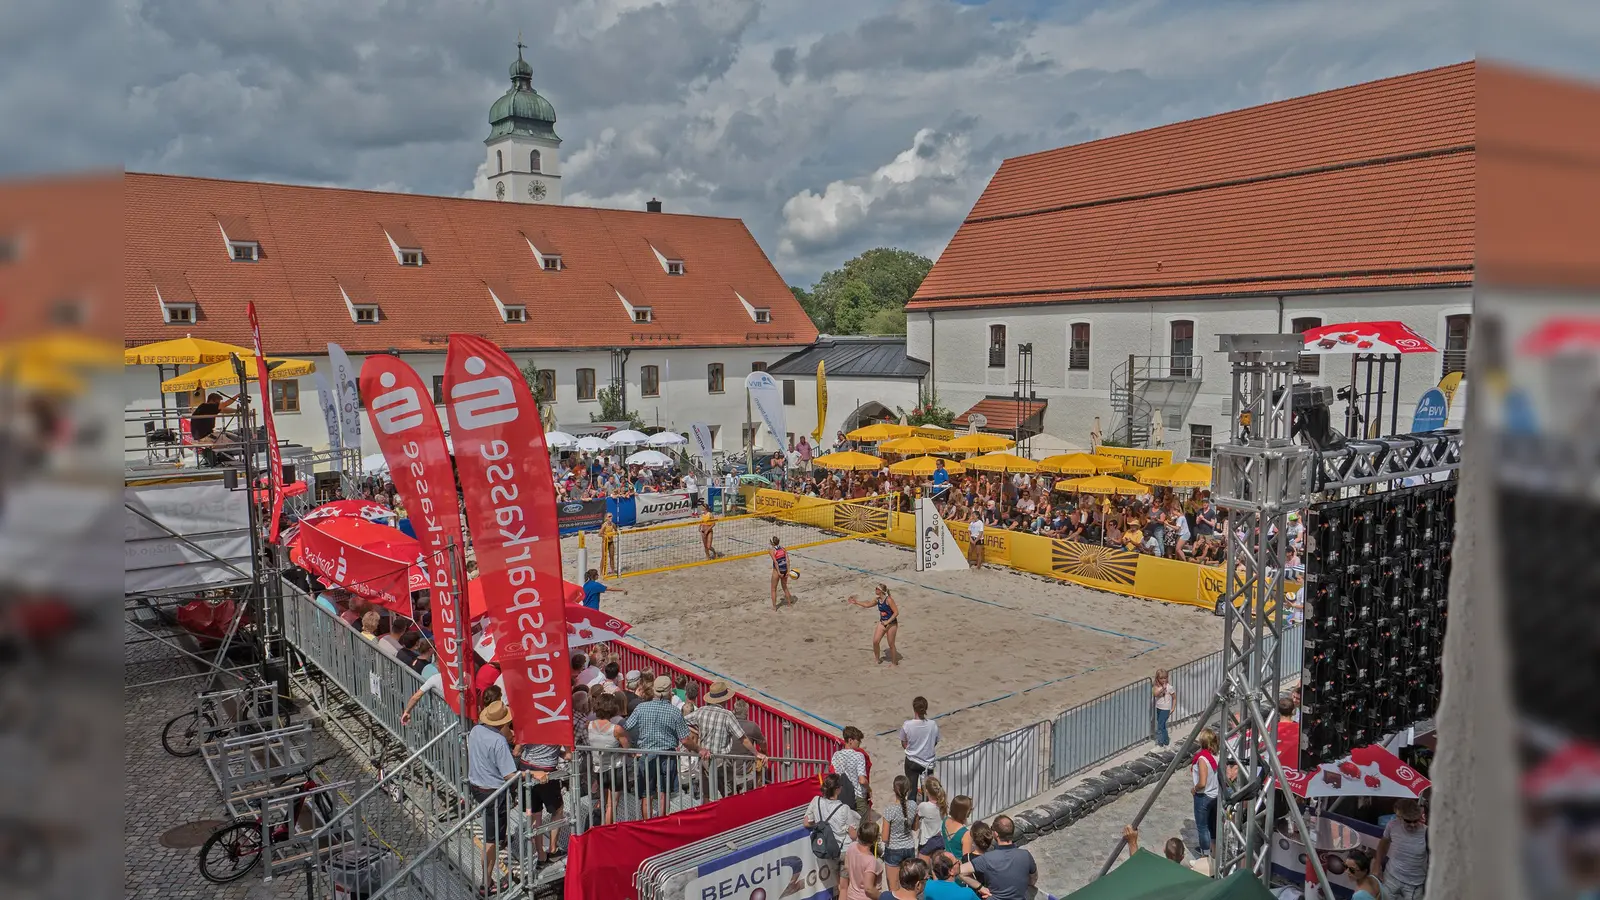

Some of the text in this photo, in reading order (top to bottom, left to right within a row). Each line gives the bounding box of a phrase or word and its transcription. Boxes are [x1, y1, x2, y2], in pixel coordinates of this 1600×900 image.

[1428, 406, 1444, 416] BVV
[641, 498, 704, 514] AUTOHAS
[1204, 577, 1223, 593] DIE
